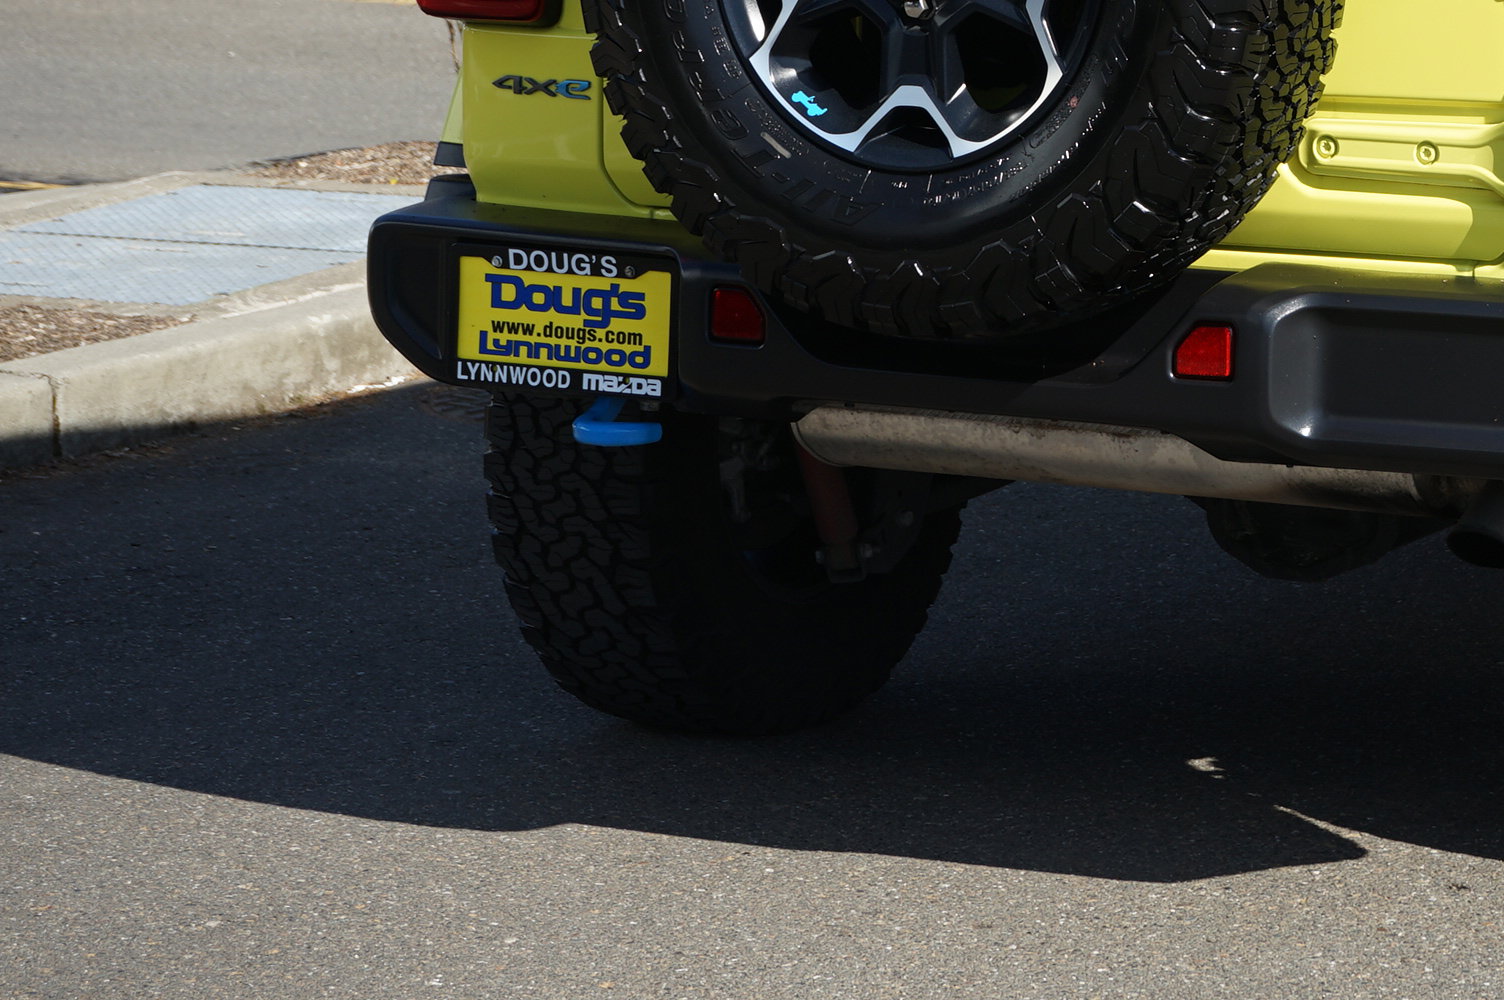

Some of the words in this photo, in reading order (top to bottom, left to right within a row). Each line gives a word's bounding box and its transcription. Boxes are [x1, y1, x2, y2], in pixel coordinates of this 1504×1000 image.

[508, 248, 618, 278] DOUG'S
[485, 273, 647, 329] Doug's
[491, 320, 643, 346] www.dougs.com
[478, 331, 652, 370] Lynnwood
[457, 361, 571, 389] LYNNWOOD
